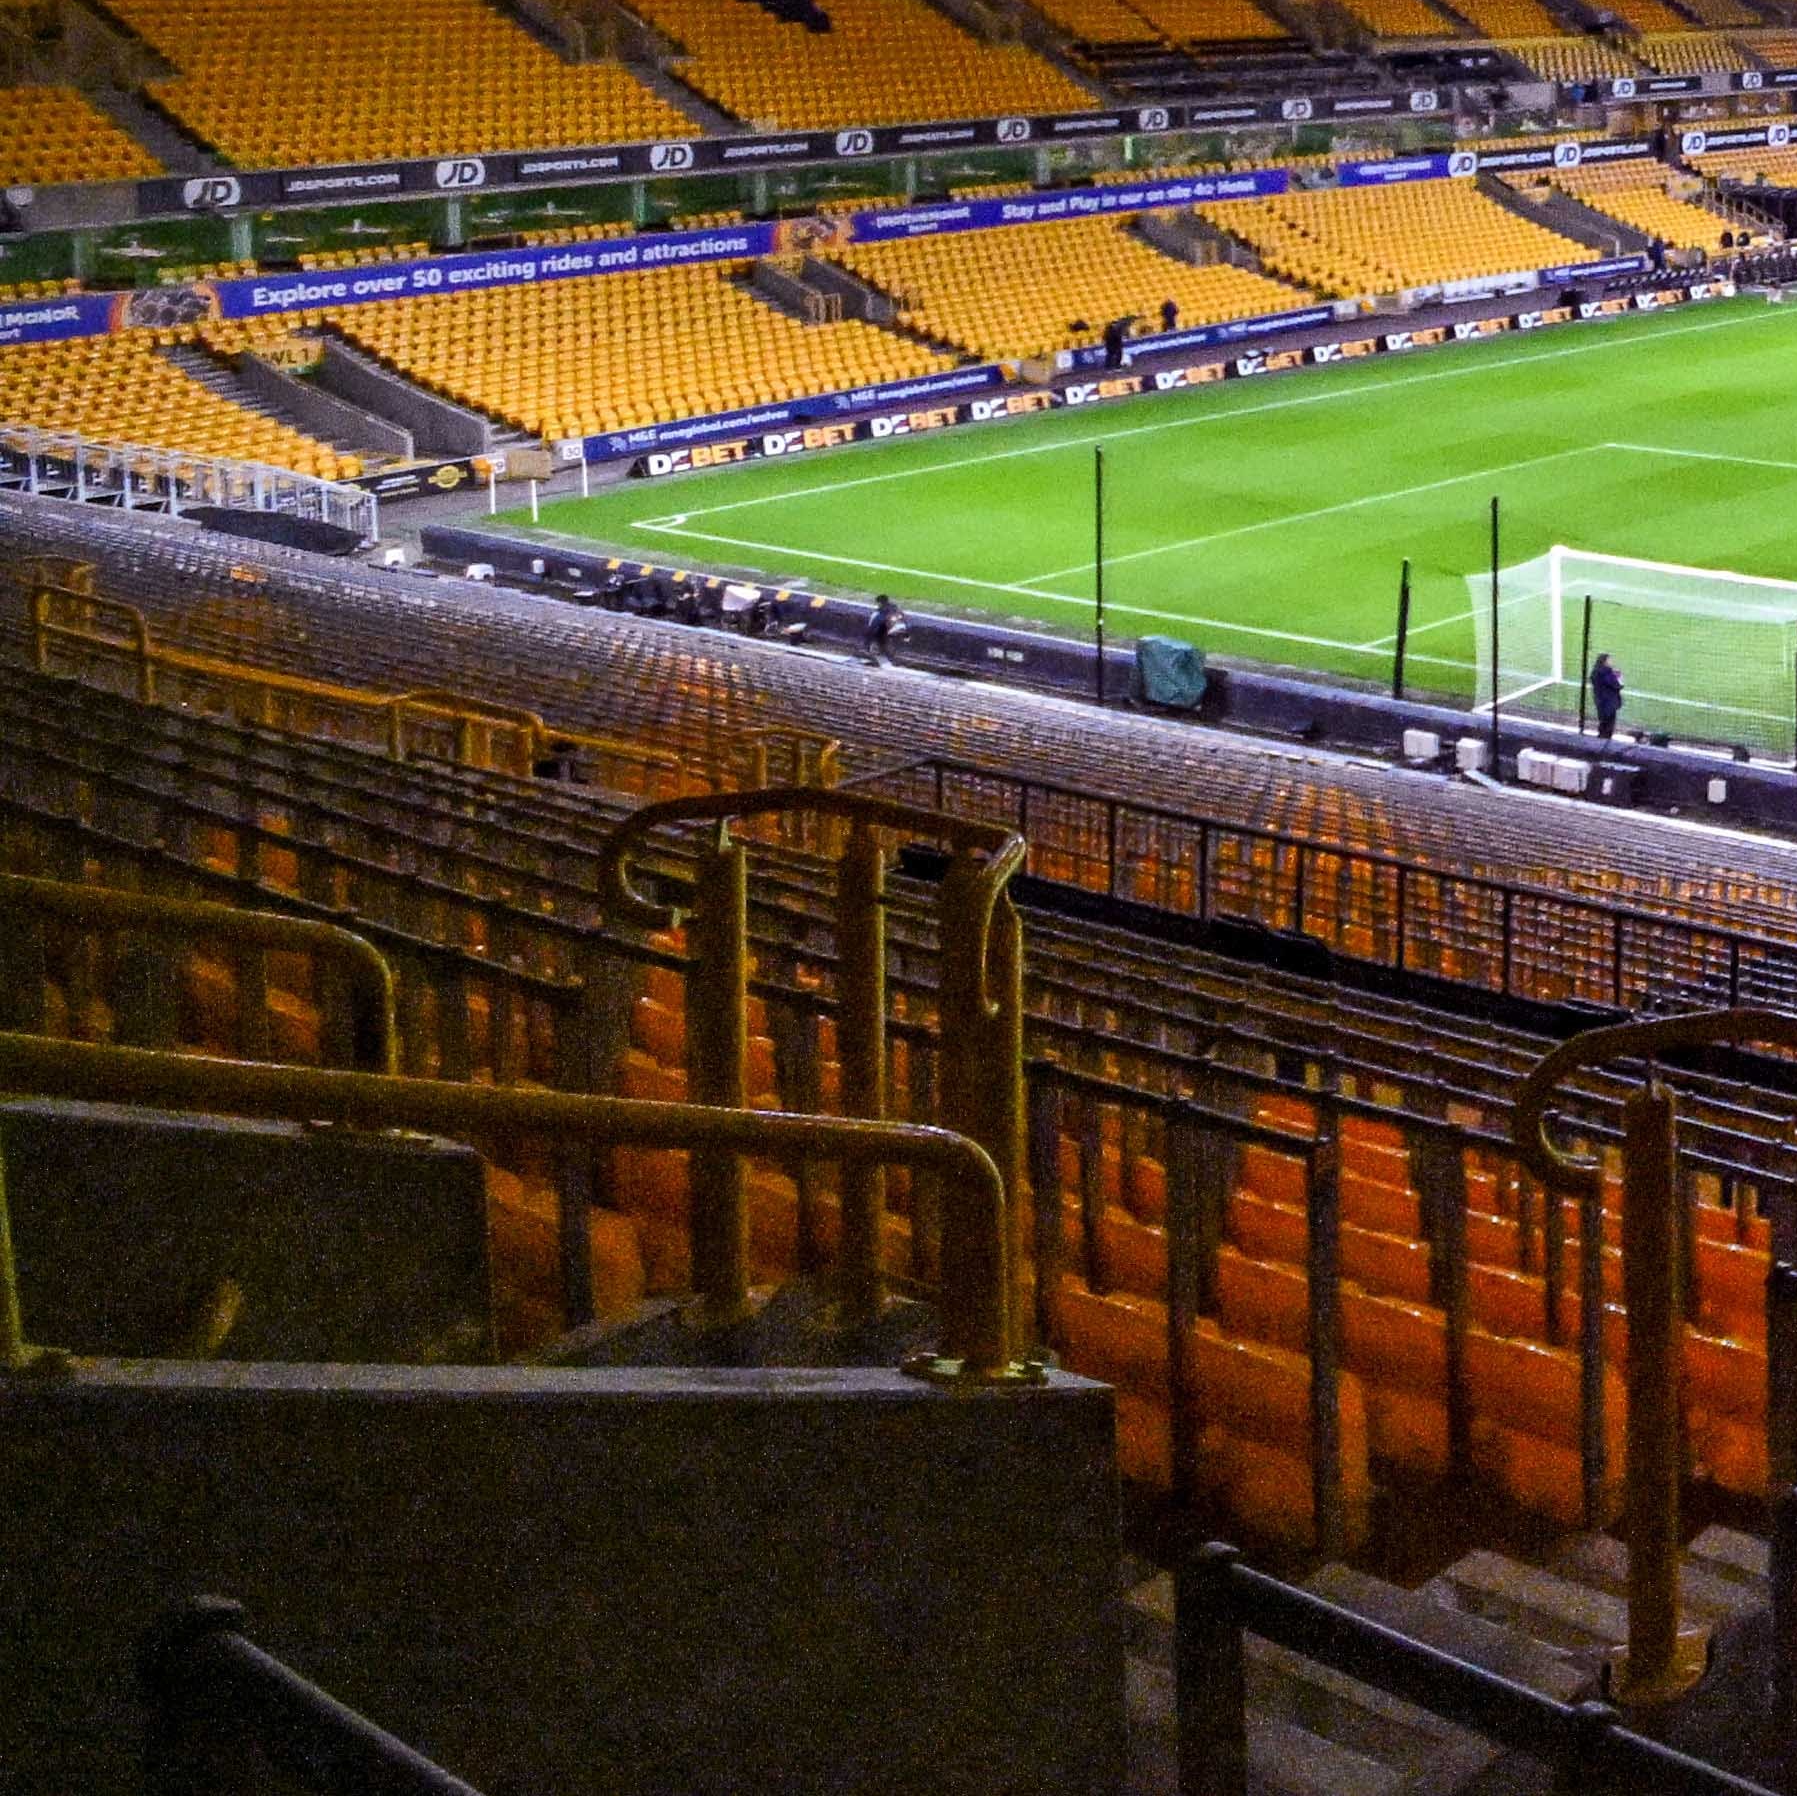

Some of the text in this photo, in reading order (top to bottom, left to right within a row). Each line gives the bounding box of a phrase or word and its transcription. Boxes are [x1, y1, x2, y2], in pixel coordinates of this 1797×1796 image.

[1002, 203, 1035, 219] Stay
[1038, 199, 1067, 214] and
[1069, 195, 1099, 212] Play
[252, 235, 748, 308] Explore over 50 exciting rides and attractions
[6, 305, 81, 326] MANOR
[1313, 337, 1376, 362] DEBET
[1386, 326, 1446, 350] DEBET
[1155, 361, 1225, 389] DEBET
[1065, 376, 1143, 404] DEBET
[971, 391, 1052, 420] DEBET
[629, 428, 657, 442] M&E
[871, 407, 957, 438] DEBET
[763, 423, 857, 456] DEBET
[650, 441, 748, 475] DEBET
